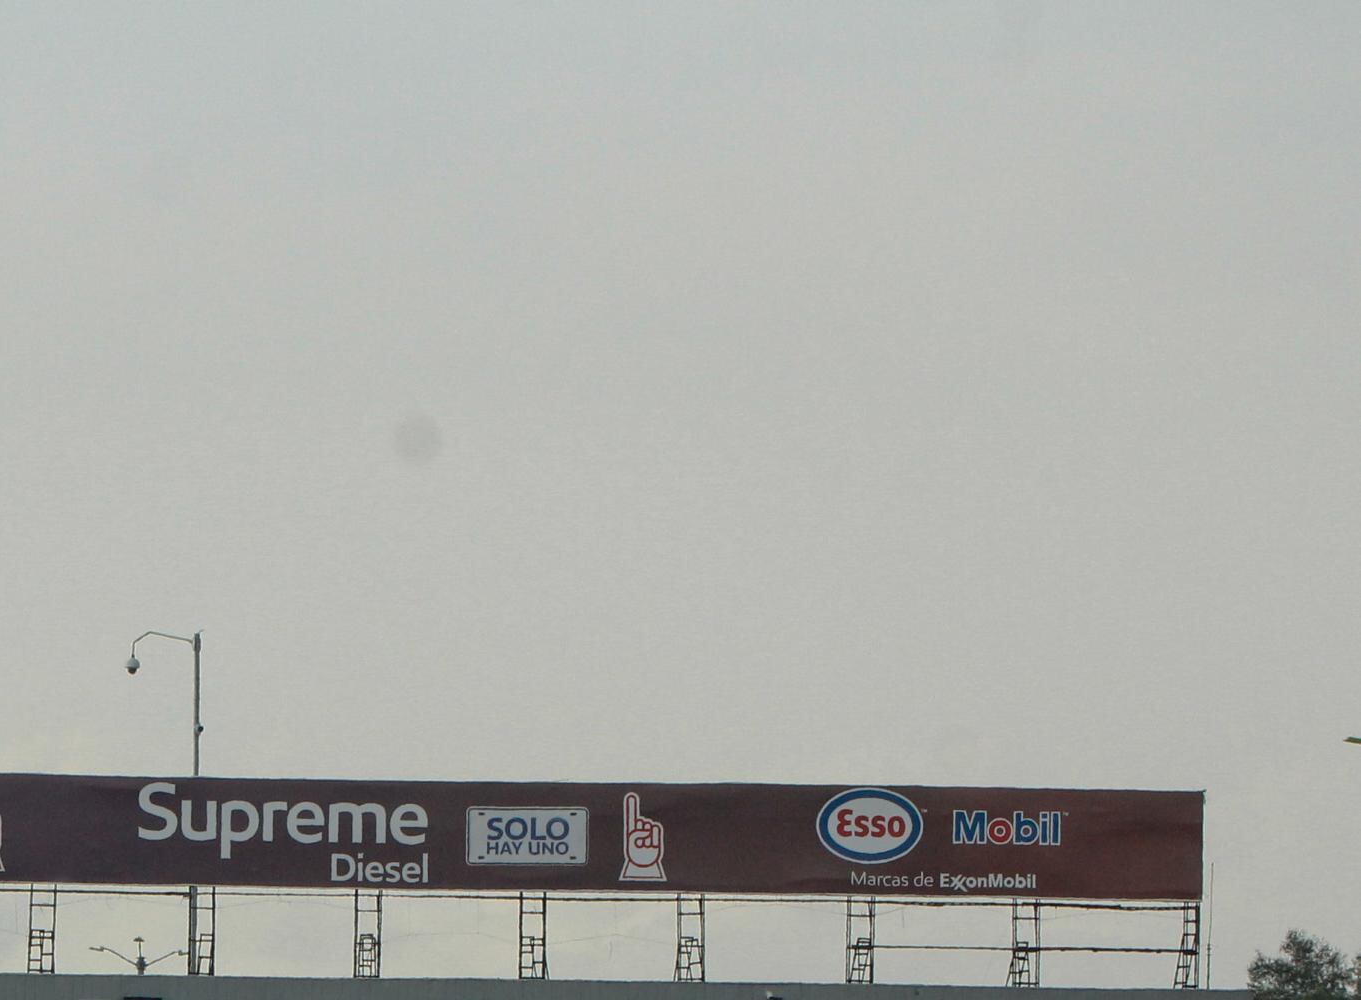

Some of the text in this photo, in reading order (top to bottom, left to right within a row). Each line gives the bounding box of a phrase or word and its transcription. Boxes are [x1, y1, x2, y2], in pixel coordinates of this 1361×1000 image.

[137, 782, 429, 859] Supreme
[486, 817, 570, 841] SOLO
[836, 808, 906, 838] Esso
[952, 809, 1061, 846] Mobil
[486, 841, 569, 855] HAY UNO
[330, 852, 429, 883] Diesel
[850, 871, 1037, 892] Marcas de ExxonMobil
